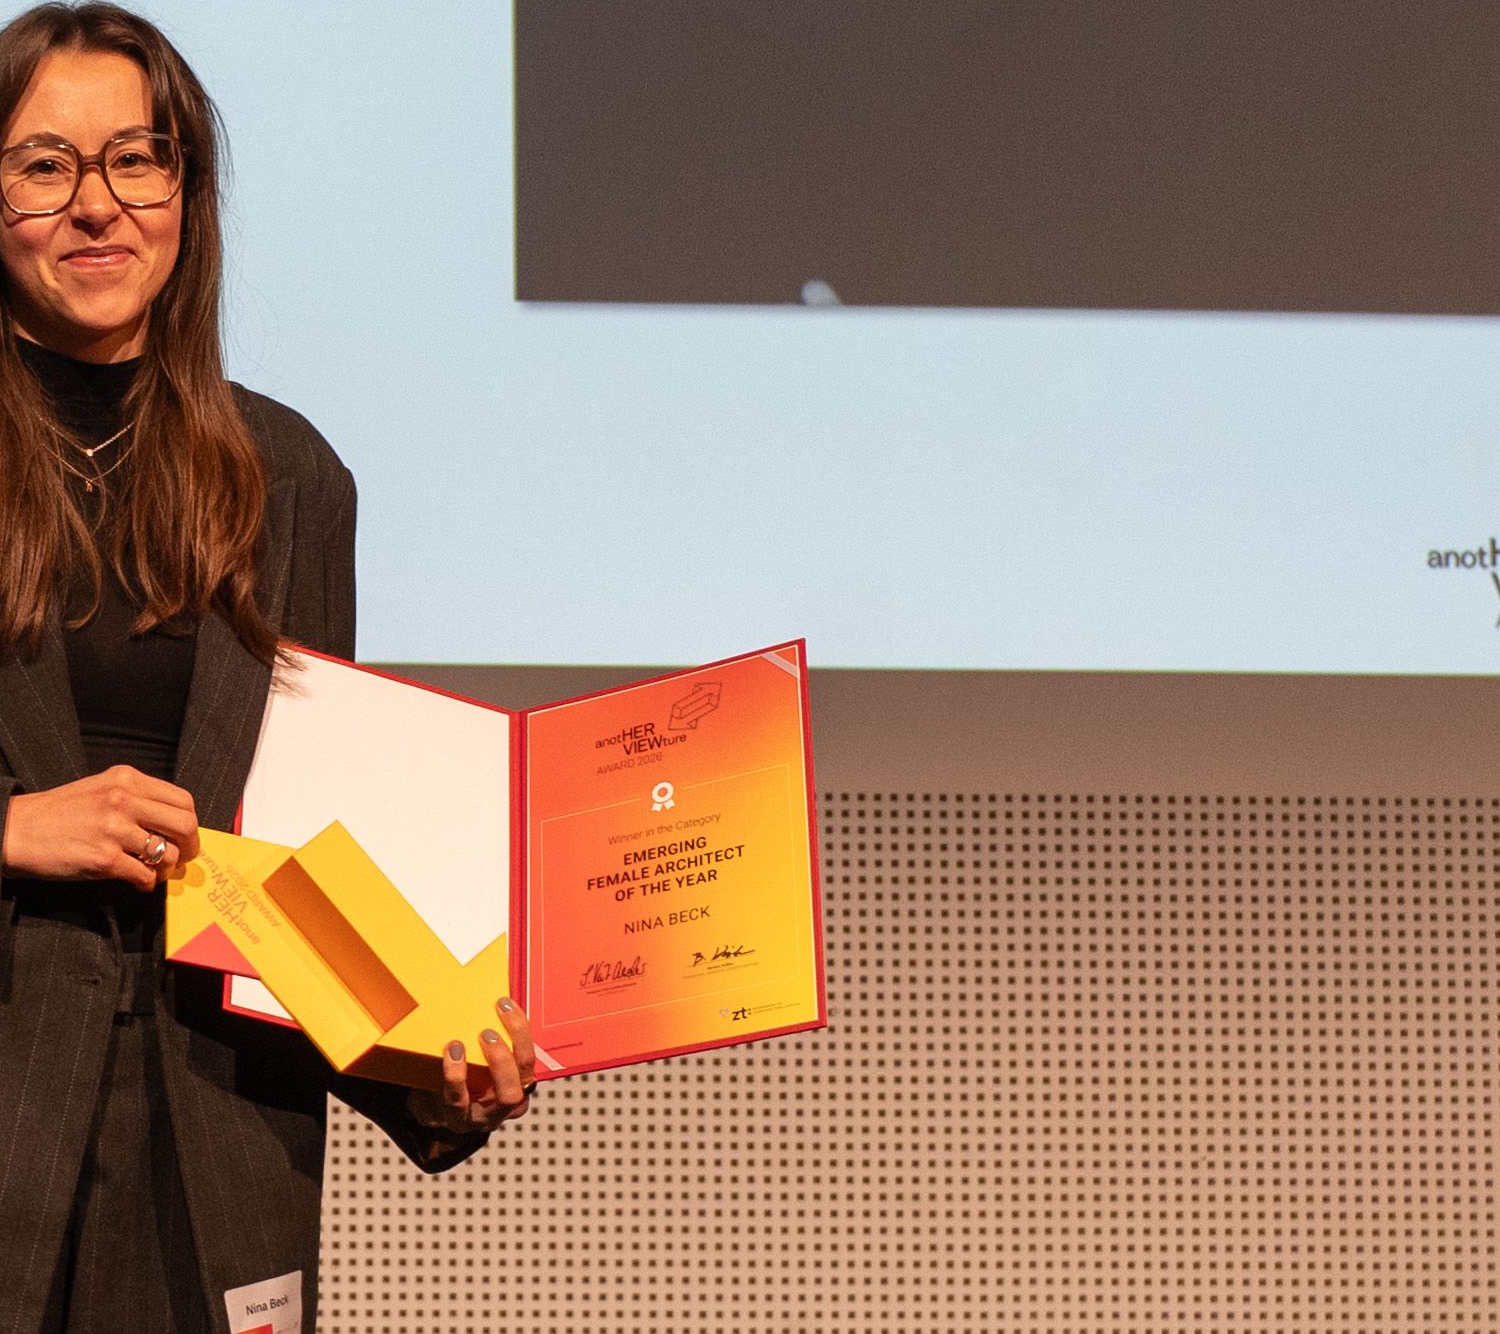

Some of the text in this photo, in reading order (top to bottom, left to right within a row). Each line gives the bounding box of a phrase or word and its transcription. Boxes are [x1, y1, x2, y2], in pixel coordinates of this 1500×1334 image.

[595, 722, 655, 749] anotHER
[622, 733, 687, 755] VIEWture
[596, 752, 663, 775] AWARD 2026
[608, 813, 722, 846] Winner in the Category
[623, 836, 707, 866] EMERGING
[587, 845, 746, 891] FEMALE ARCHITECT
[615, 869, 718, 902] OF THE YEAR
[624, 905, 711, 935] NINA BECK
[246, 1293, 289, 1316] Nina Beck
